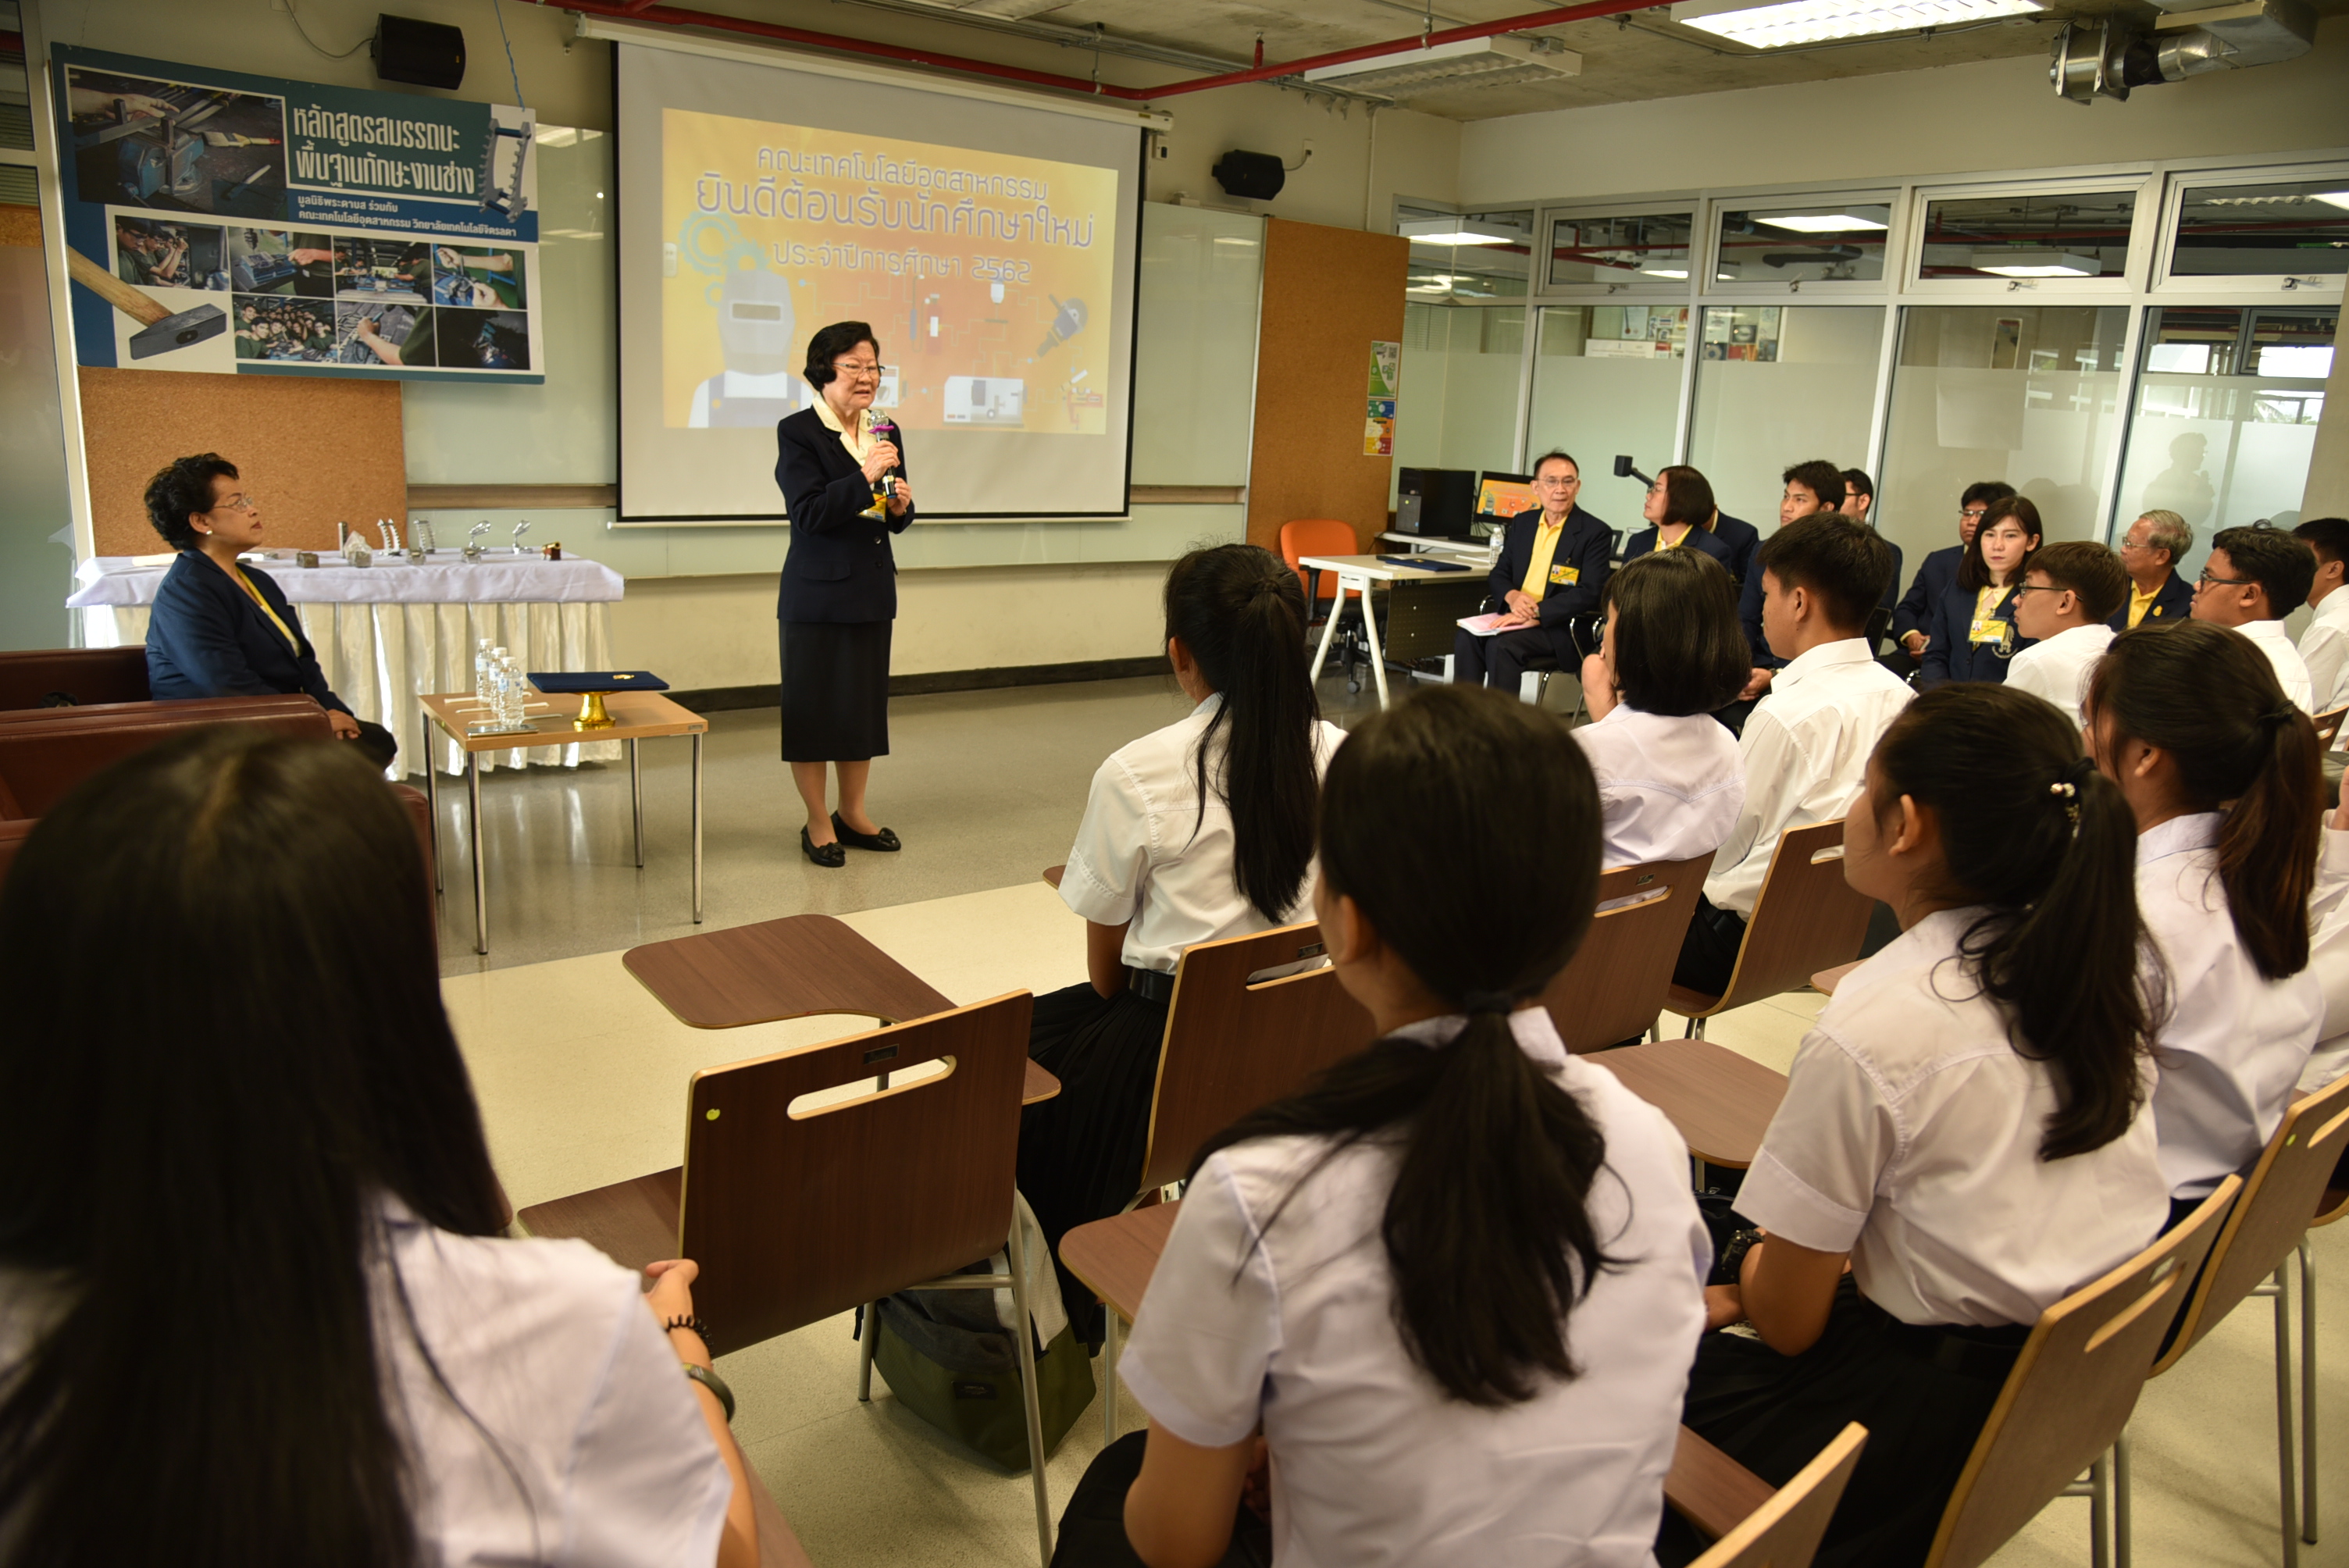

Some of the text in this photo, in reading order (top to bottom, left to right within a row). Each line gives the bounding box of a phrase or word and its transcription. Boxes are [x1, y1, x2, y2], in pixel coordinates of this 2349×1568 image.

[294, 103, 460, 152] หลักสูตรสมรรถนะ
[296, 140, 475, 194] พื้นฐานทักษะงานช่าง
[758, 146, 1048, 201] คณะเทคโนโลยีอุตสาหกรรม
[697, 172, 1093, 248] ยินดีต้อนรับนักศึกษาใหม่
[773, 240, 1032, 284] ประจำปีการศึกษา 2562
